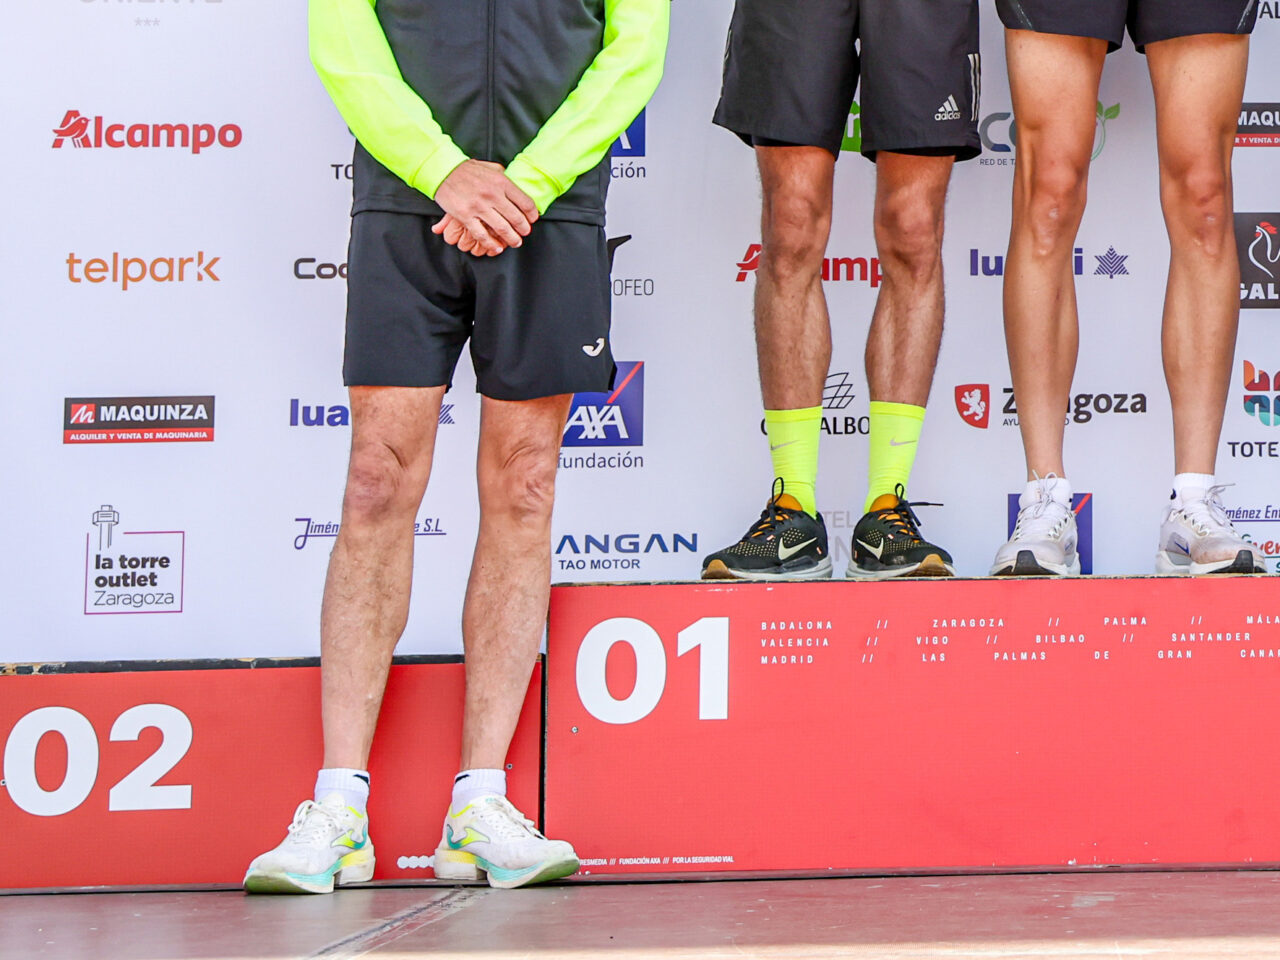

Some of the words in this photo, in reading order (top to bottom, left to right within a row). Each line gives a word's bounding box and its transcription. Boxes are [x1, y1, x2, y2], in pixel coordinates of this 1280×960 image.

[935, 110, 961, 122] adidas
[52, 110, 243, 154] Alcampo
[980, 158, 995, 166] RED
[997, 158, 1007, 166] DE
[66, 251, 221, 291] telpark
[613, 279, 655, 296] OFEO
[100, 404, 208, 423] MAQUINZA
[290, 399, 349, 427] lua
[567, 405, 629, 439] AXA
[70, 431, 107, 441] ALQUILER
[109, 431, 115, 440] Y
[116, 431, 142, 440] VENTA
[144, 431, 154, 440] DE
[156, 430, 208, 440] MAQUINARIA
[558, 451, 644, 468] fundación
[1225, 505, 1261, 521] ménez
[294, 518, 338, 550] Jimén
[556, 533, 698, 553] ANGAN
[94, 555, 113, 570] la
[119, 554, 171, 570] torre
[559, 559, 586, 570] TAO
[589, 559, 641, 570] MOTOR
[94, 572, 158, 588] outlet
[93, 590, 175, 608] Zaragoza
[761, 622, 832, 631] BADALONA
[932, 619, 1004, 628] ZARAGOZA
[1104, 617, 1147, 626] PALMA
[761, 638, 829, 647] VALENCIA
[916, 636, 949, 645] VIGO
[1035, 634, 1085, 643] BILBAO
[1171, 632, 1251, 641] SANTANDER
[761, 654, 814, 664] MADRID
[921, 653, 946, 662] LAS
[994, 651, 1047, 661] PALMAS
[1094, 651, 1110, 660] DE
[1157, 650, 1192, 659] GRAN
[575, 616, 730, 725] 01
[3, 702, 194, 818] 02
[579, 858, 607, 866] RESMEDIA
[619, 857, 650, 865] FUNDACIÓN
[692, 856, 722, 864] SEGURIDAD
